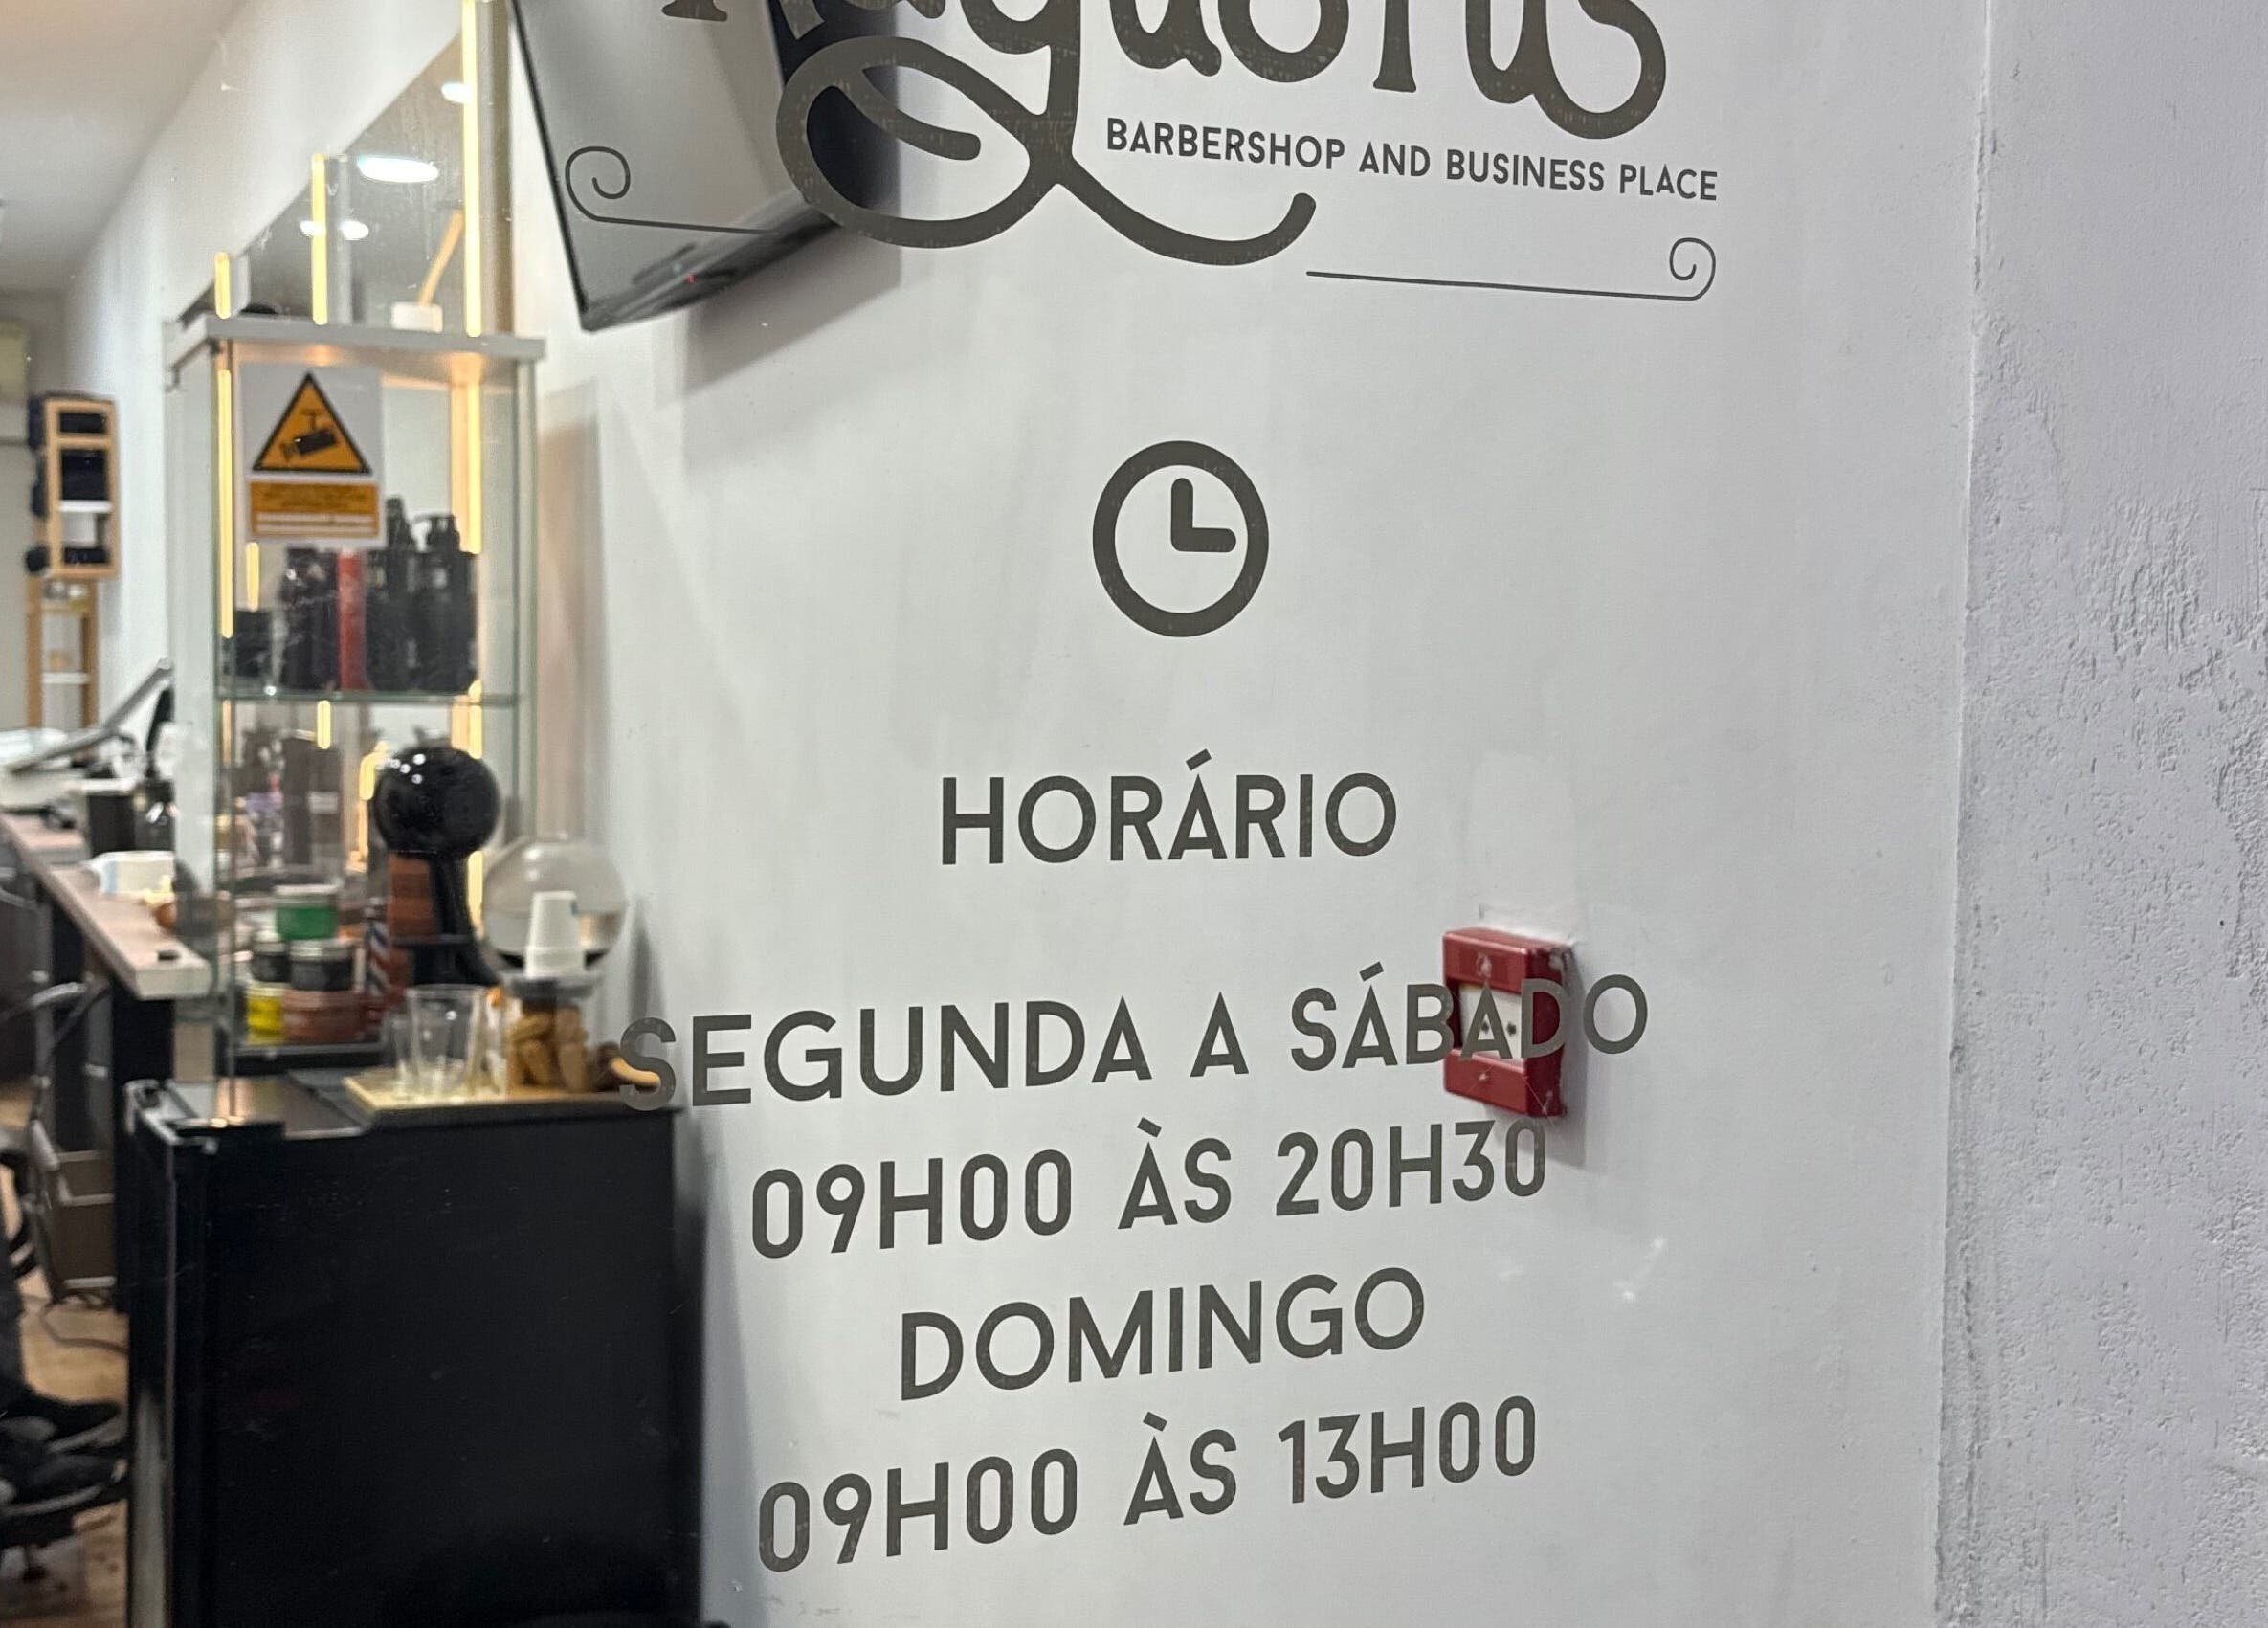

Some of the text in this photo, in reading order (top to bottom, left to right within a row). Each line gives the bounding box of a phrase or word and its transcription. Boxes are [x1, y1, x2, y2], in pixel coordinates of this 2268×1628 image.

[1107, 117, 1718, 201] BARBERSHOP AND BUSINESS PLACE
[942, 748, 1397, 865] HORÁRIO
[618, 961, 1648, 1112] SEGUNDA A SÁBADO
[752, 1117, 1546, 1259] 09H00 ÀS 20H30
[901, 1267, 1425, 1401] DOMINGO
[758, 1395, 1536, 1572] 09H00 ÀS 13H00
